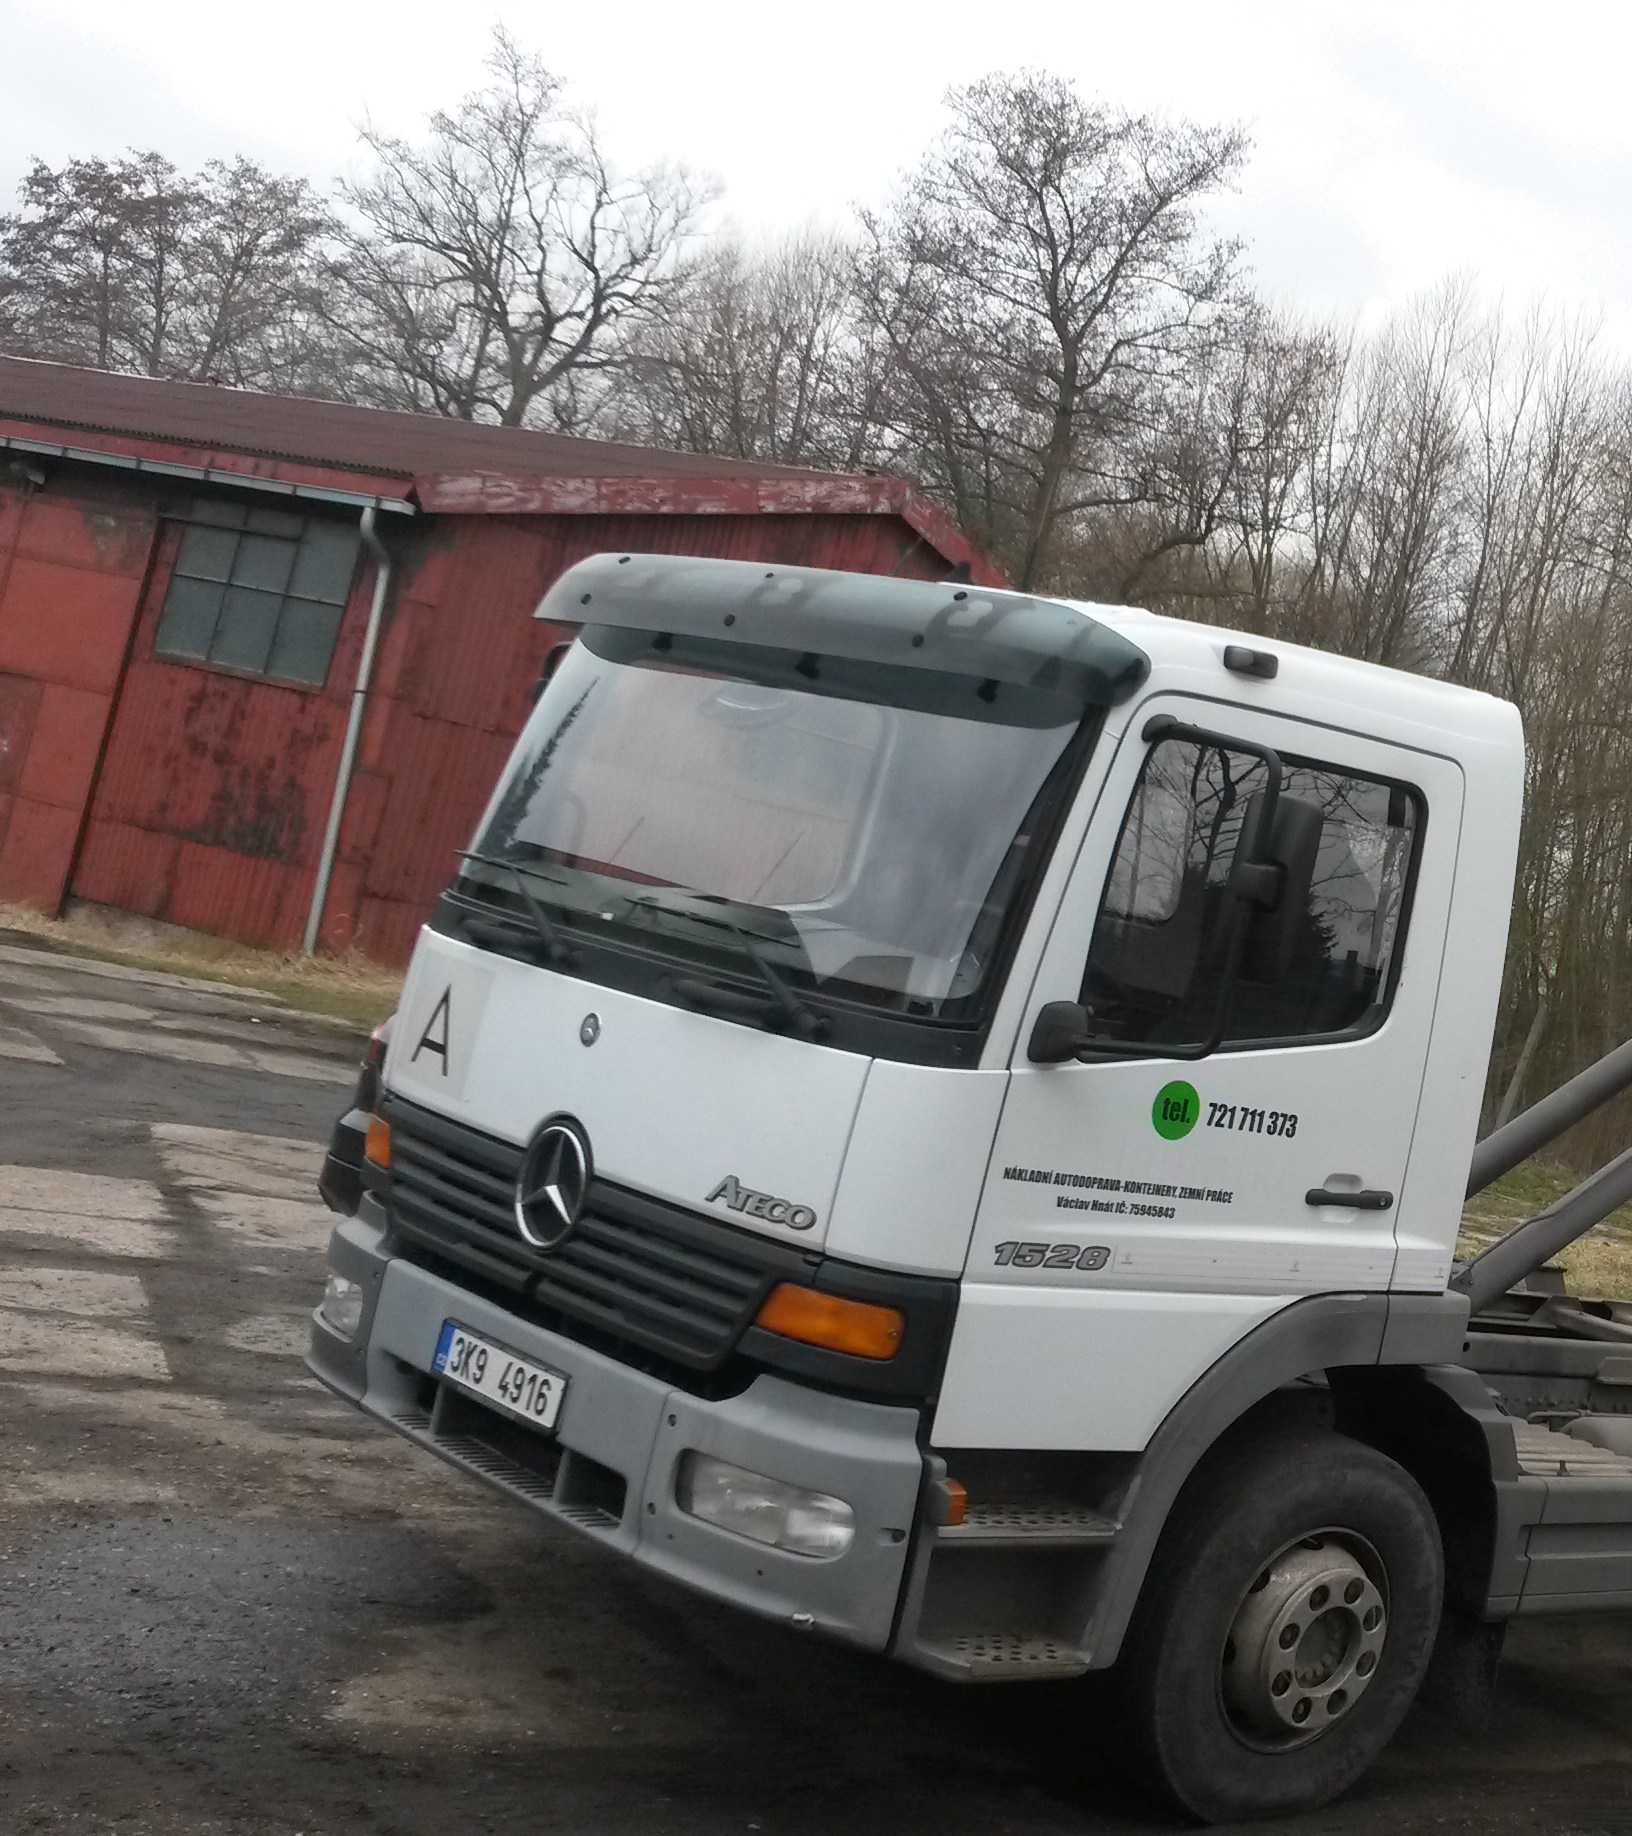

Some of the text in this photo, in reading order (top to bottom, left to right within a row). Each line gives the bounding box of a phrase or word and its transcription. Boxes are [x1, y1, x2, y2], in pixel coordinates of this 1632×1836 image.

[411, 983, 451, 1076] A
[1162, 1098, 1298, 1138] tel. 721 711 373
[1003, 1166, 1053, 1184] NÁKLADNÍ
[1179, 1187, 1206, 1200] ZEMNÍ
[1206, 1189, 1233, 1203] PRÁCE
[1057, 1196, 1090, 1210] Václav
[1091, 1200, 1114, 1213] Hnát
[1129, 1203, 1175, 1219] 75945843
[994, 1241, 1111, 1271] 1528
[450, 1337, 552, 1416] 3K9 4916
